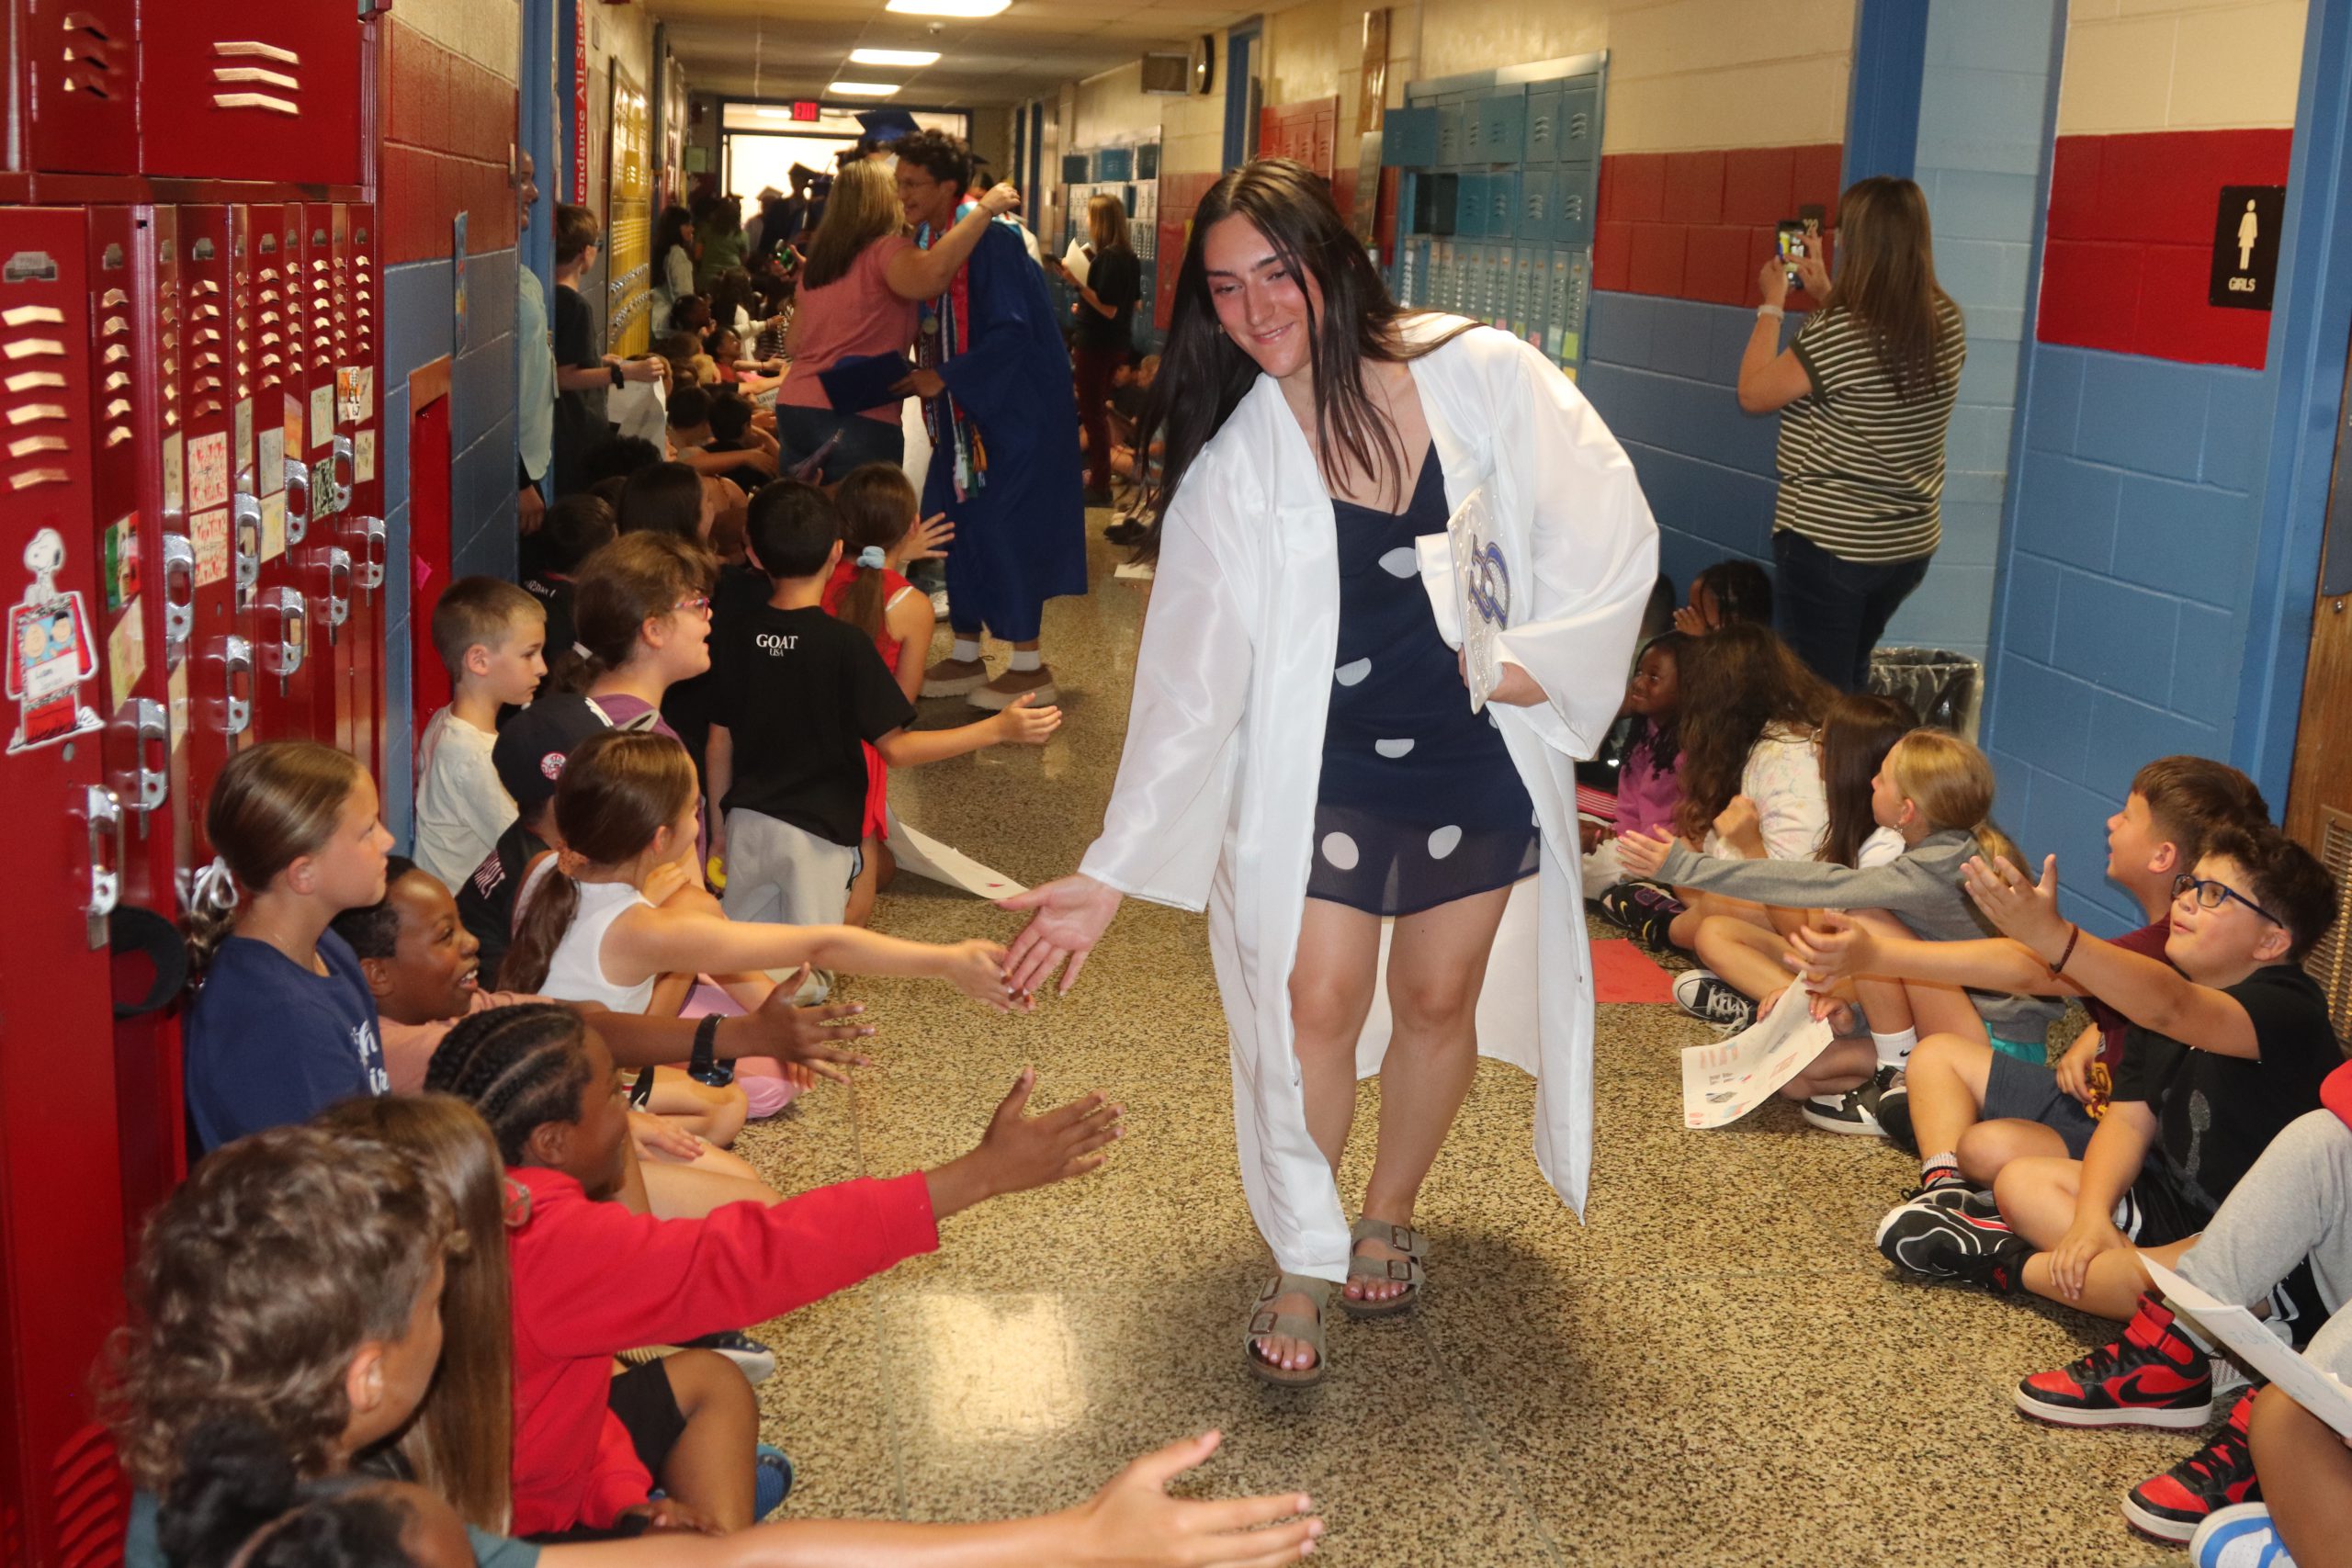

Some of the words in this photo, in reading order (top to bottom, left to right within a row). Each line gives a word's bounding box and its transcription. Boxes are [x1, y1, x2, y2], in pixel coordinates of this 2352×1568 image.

[794, 102, 817, 120] EXIT
[2228, 276, 2256, 292] GIRLS
[755, 634, 798, 649] GOAT
[769, 648, 784, 657] USA
